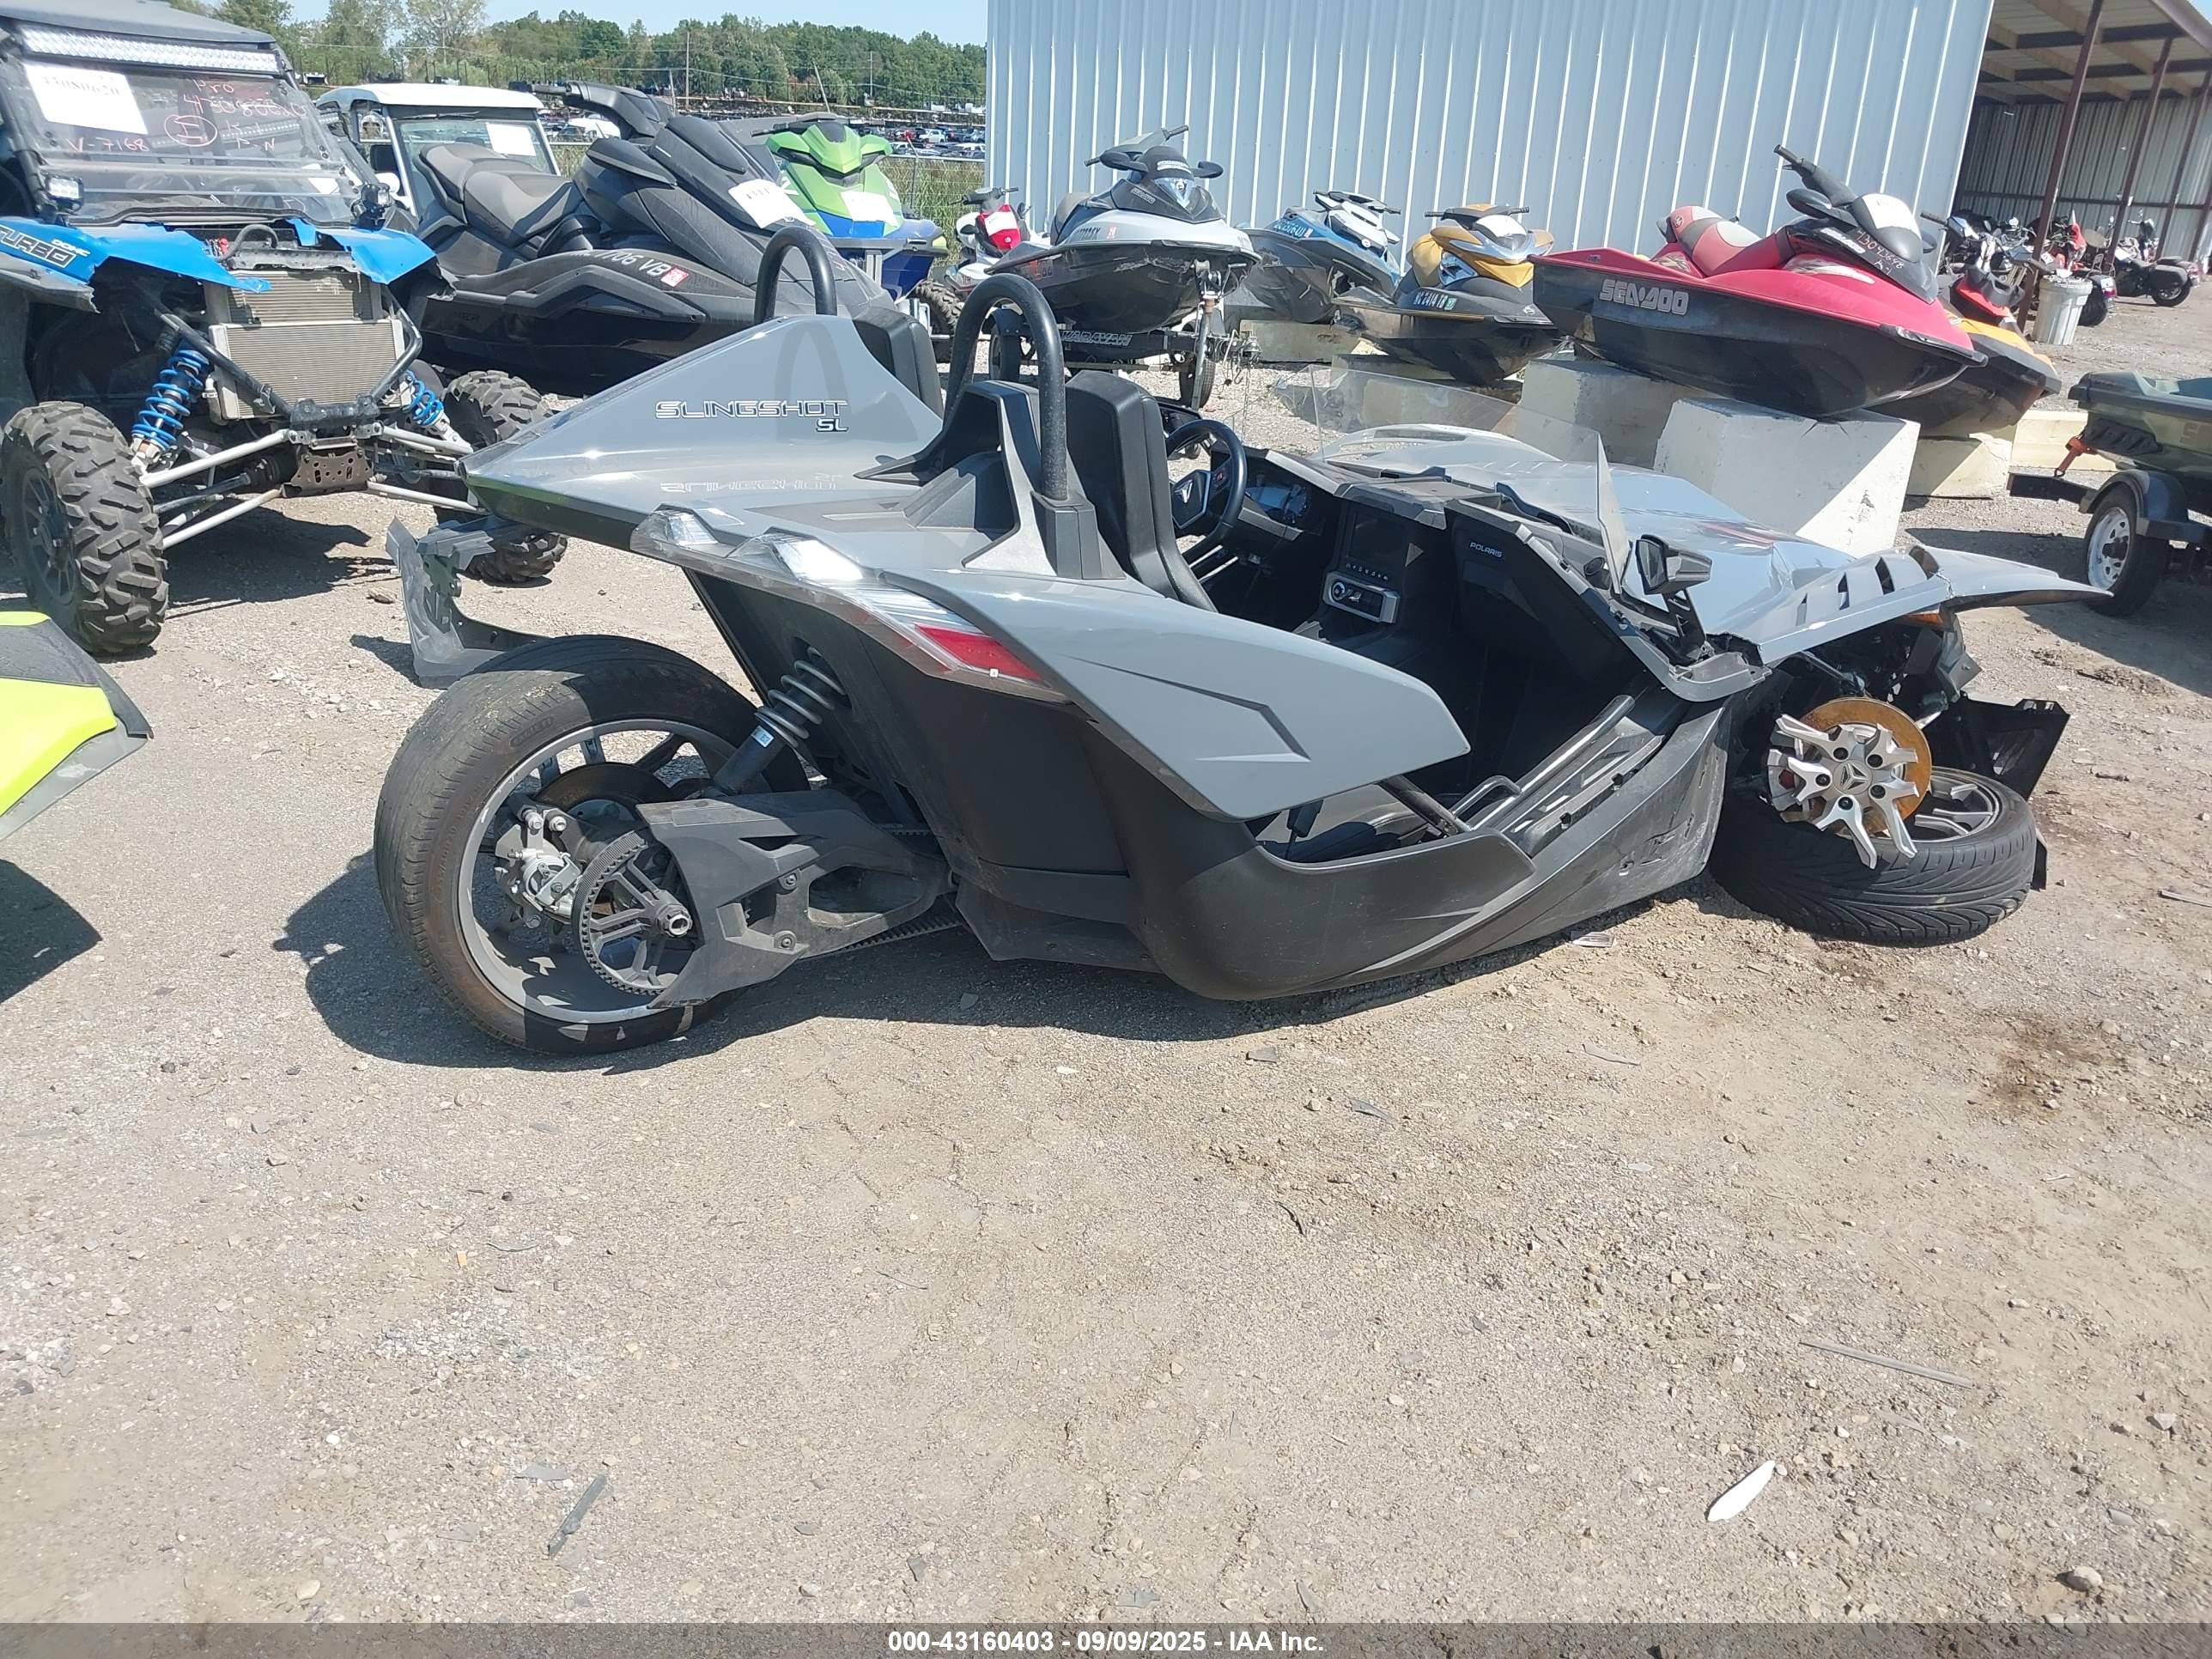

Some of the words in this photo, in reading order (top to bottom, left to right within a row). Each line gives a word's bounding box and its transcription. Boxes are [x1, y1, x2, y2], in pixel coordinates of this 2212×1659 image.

[0, 224, 77, 269] URBO
[639, 259, 672, 276] VB
[655, 400, 848, 419] SLINGSHOT
[816, 418, 848, 432] SL
[1470, 542, 1503, 557] POLARIS
